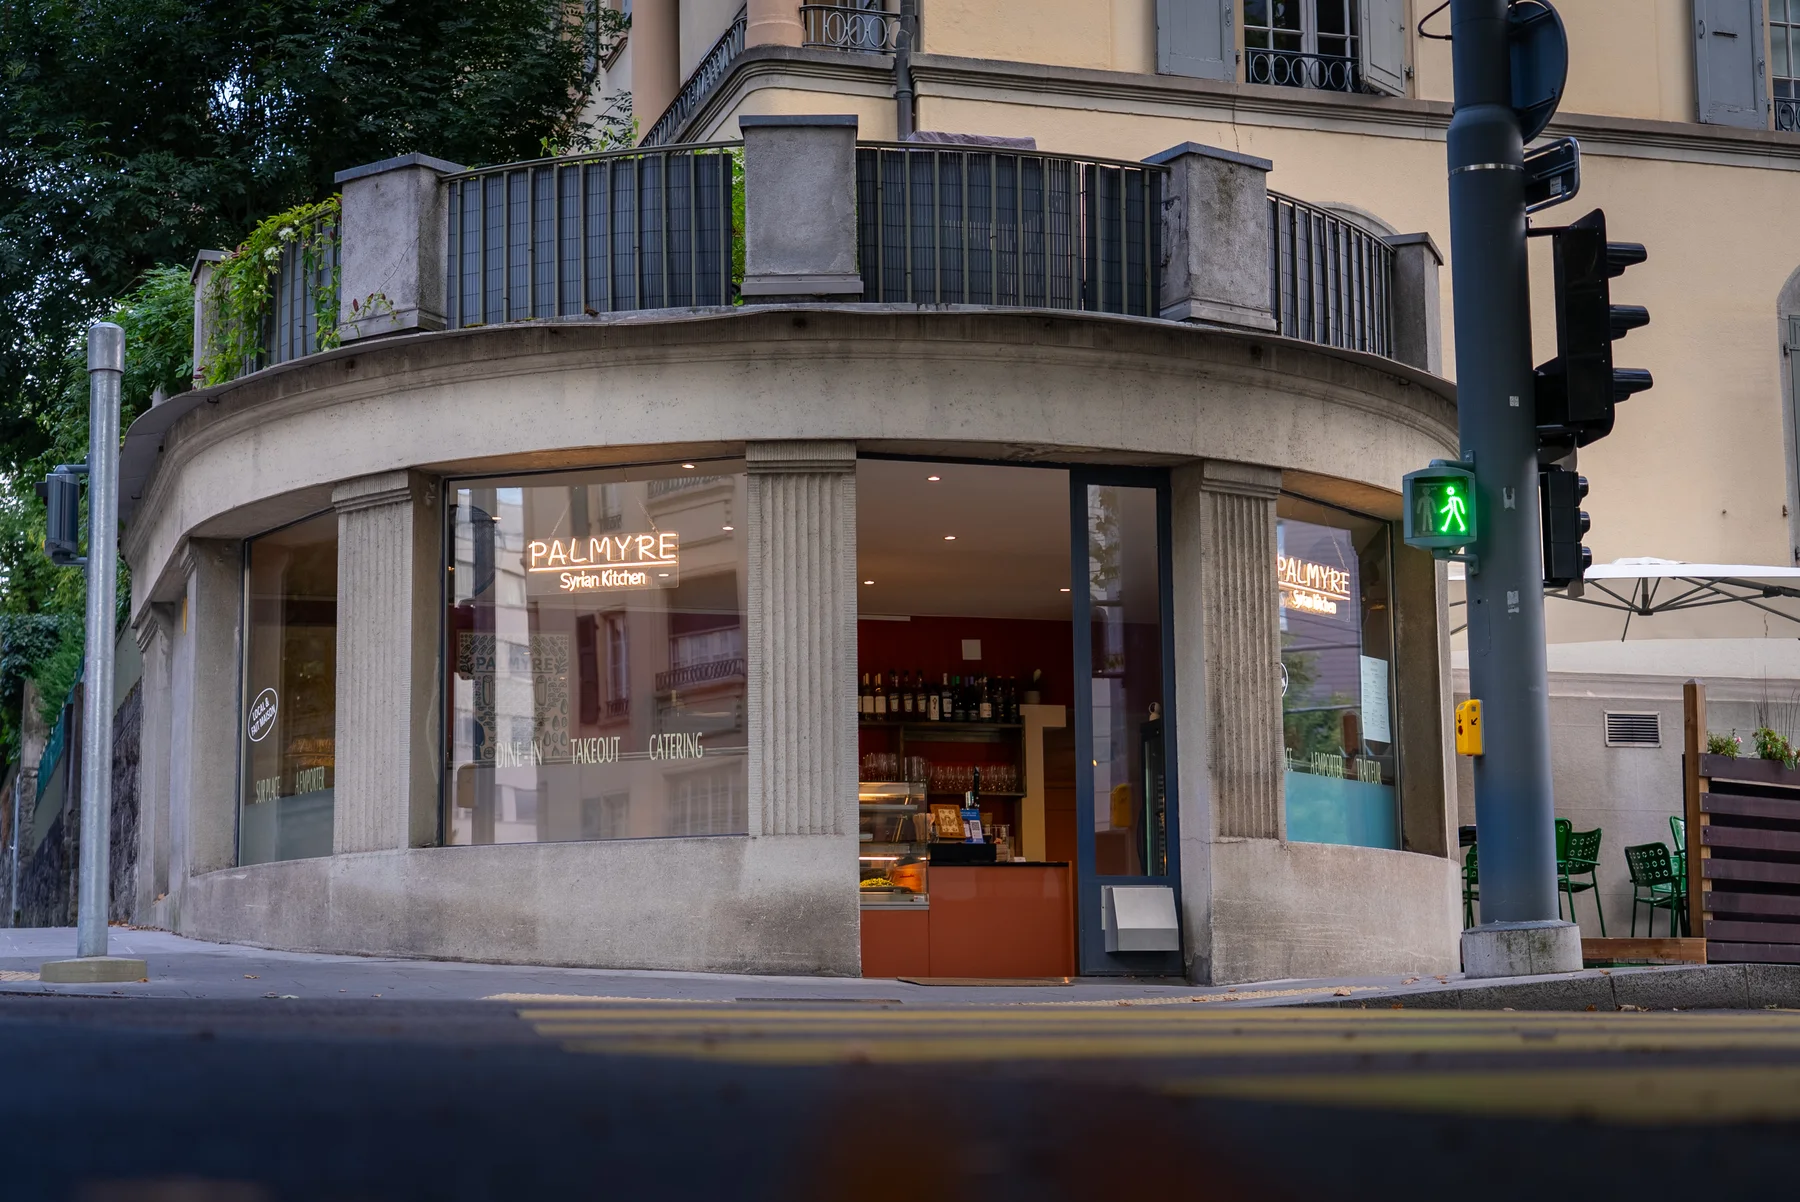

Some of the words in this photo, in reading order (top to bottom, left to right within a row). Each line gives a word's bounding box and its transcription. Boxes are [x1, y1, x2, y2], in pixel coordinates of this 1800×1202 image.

[528, 532, 677, 567] PALMYRE
[560, 570, 599, 591] Syrian
[601, 569, 646, 587] Kitchen
[1277, 553, 1350, 595] PALMYRE
[476, 656, 554, 671] PAMYRE
[252, 701, 266, 721] LOCAL
[496, 740, 543, 769] DINE-IN
[570, 736, 621, 765] TAKEOUT
[649, 732, 704, 761] CATERING
[1314, 752, 1344, 779] EMPORTER
[1356, 758, 1382, 785] TRAITEUR
[299, 766, 325, 795] EMPORTER
